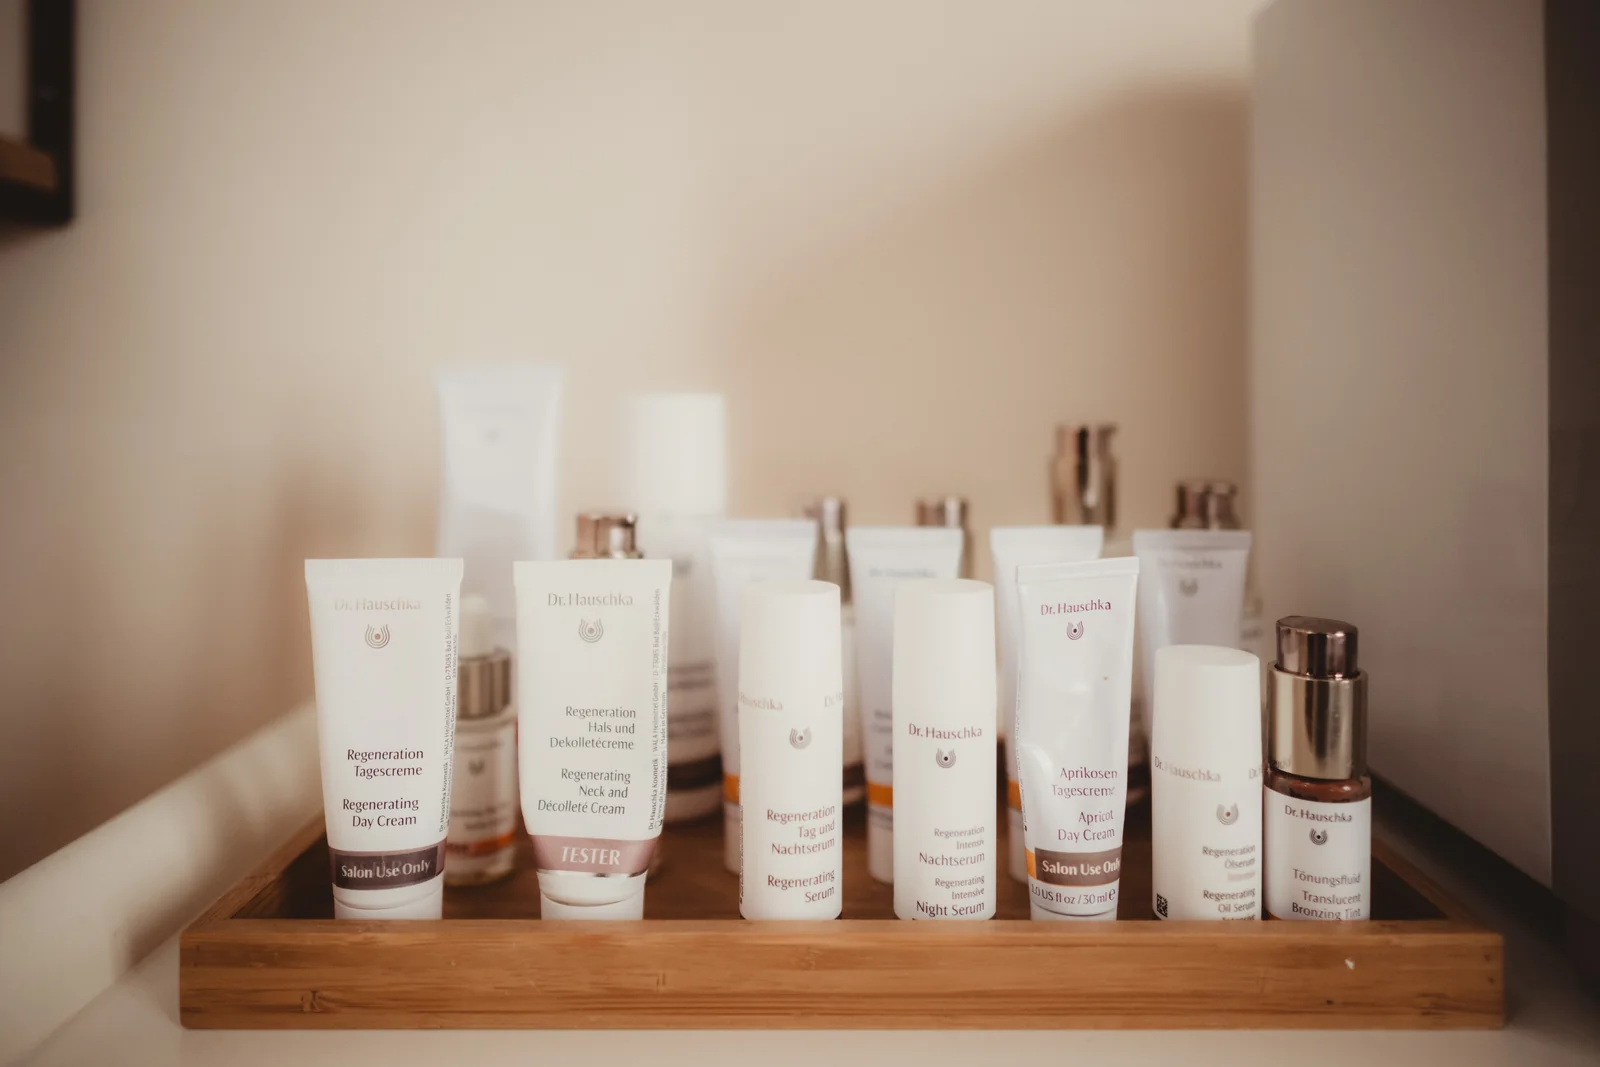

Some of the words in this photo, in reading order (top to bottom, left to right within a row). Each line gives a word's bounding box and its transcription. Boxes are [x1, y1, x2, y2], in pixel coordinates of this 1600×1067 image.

[334, 598, 353, 611] Dr.
[355, 597, 422, 611] Hauschka
[547, 592, 566, 606] Dr.
[568, 591, 634, 606] Hauschka
[1040, 603, 1056, 615] Dr.
[1057, 599, 1112, 614] Hauschka
[565, 705, 637, 719] Regeneration
[588, 721, 612, 734] Hals
[615, 722, 636, 735] und
[908, 722, 924, 738] Dr.
[925, 725, 983, 740] Hauschka
[549, 736, 635, 750] Dekolletécreme
[346, 748, 424, 763] Regeneration
[353, 765, 423, 780] Tagescreme
[561, 768, 631, 784] Regenerating
[1059, 766, 1118, 781] Aprikosen
[578, 785, 605, 797] Neck
[607, 786, 629, 799] and
[1052, 784, 1116, 799] Tagescreme
[342, 797, 420, 814] Regenerating
[537, 799, 588, 813] Décolleté
[590, 801, 626, 815] Cream
[1284, 804, 1299, 818] Dr.
[1300, 809, 1353, 823] Hauschka
[352, 815, 375, 830] Day
[377, 814, 417, 828] Cream
[766, 805, 835, 825] Regeneration
[1078, 809, 1115, 826] Apricot
[797, 826, 817, 840] Tag
[819, 818, 835, 836] und
[934, 826, 985, 839] Regeneration
[1057, 828, 1080, 844] Day
[1082, 827, 1116, 842] Cream
[771, 837, 835, 856] Nachtserum
[956, 839, 985, 851] Intensiv
[1202, 844, 1256, 858] Regeneration
[561, 846, 621, 866] TESTER
[919, 851, 985, 867] Nachtserum
[341, 864, 374, 879] Salon
[375, 861, 401, 879] Use
[402, 859, 431, 876] Only
[1042, 859, 1078, 876] Salon
[1079, 863, 1102, 877] Use
[767, 869, 835, 891] Regenerating
[934, 875, 985, 890] Regenerating
[1292, 867, 1361, 888] Tönungsfluid
[804, 886, 835, 903] Serum
[951, 887, 985, 900] Intensive
[1041, 889, 1054, 901] US
[1055, 892, 1062, 903] fl
[1063, 896, 1076, 904] oz
[1083, 894, 1095, 905] 30
[1203, 888, 1256, 902] Regenerating
[1302, 890, 1361, 905] Translucent
[916, 900, 948, 918] Night
[951, 902, 985, 916] Serum
[1217, 903, 1231, 914] Oil
[1233, 901, 1256, 914] Serum
[1292, 901, 1342, 920] Bronzing
[1344, 907, 1361, 920] Tint
